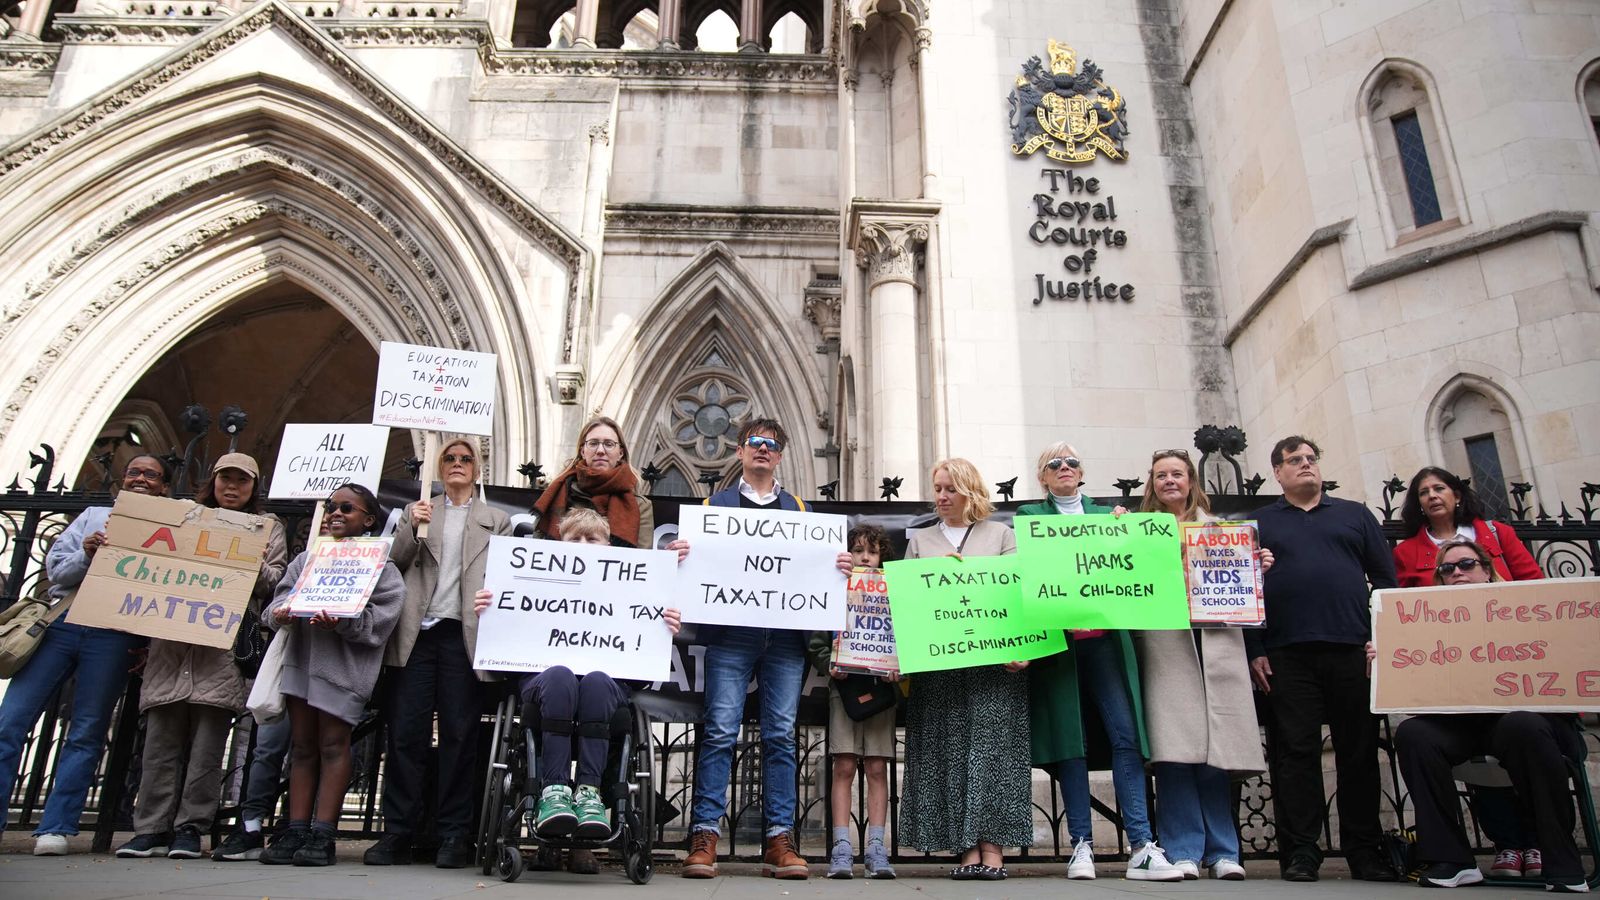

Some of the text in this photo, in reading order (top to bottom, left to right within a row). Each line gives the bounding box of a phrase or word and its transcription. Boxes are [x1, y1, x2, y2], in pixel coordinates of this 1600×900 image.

[1041, 168, 1100, 193] The
[1033, 193, 1118, 224] Royal
[1029, 219, 1127, 246] Courts
[1063, 248, 1097, 273] of
[1033, 274, 1135, 304] Justice
[407, 351, 478, 368] EDUCATION
[413, 370, 469, 388] TAXATION
[380, 390, 492, 416] DISCRIMINATION
[316, 433, 345, 452] ALL
[288, 455, 369, 472] CHILDREN
[703, 513, 843, 544] EDUCATION
[1030, 518, 1173, 538] EDUCATION TAX
[1188, 533, 1250, 547] LABOUR
[319, 546, 381, 558] LABOUR
[1204, 549, 1235, 557] TAXES
[509, 546, 648, 582] SEND THE
[744, 555, 791, 574] NOT
[1075, 552, 1134, 575] HARMS
[1191, 559, 1250, 568] VULNERABLE
[316, 575, 357, 586] KIDS
[847, 578, 887, 593] LABO
[1202, 569, 1241, 584] KIDS
[700, 583, 828, 611] TAXATION
[1038, 583, 1154, 598] ALL CHILDREN
[1191, 586, 1254, 595] OUT OF THEIR
[497, 591, 664, 621] EDUCATION TAX
[847, 604, 892, 615] VULNERA
[1201, 597, 1246, 606] SCHOOLS
[935, 608, 1008, 621] EDUCATION
[1396, 599, 1471, 624] When
[854, 614, 892, 632] KIDS
[842, 630, 860, 640] OUT
[863, 632, 875, 641] OF
[929, 630, 1048, 657] DISCRIMINATION
[850, 642, 893, 654] SCHOOLS
[1469, 639, 1548, 664] class
